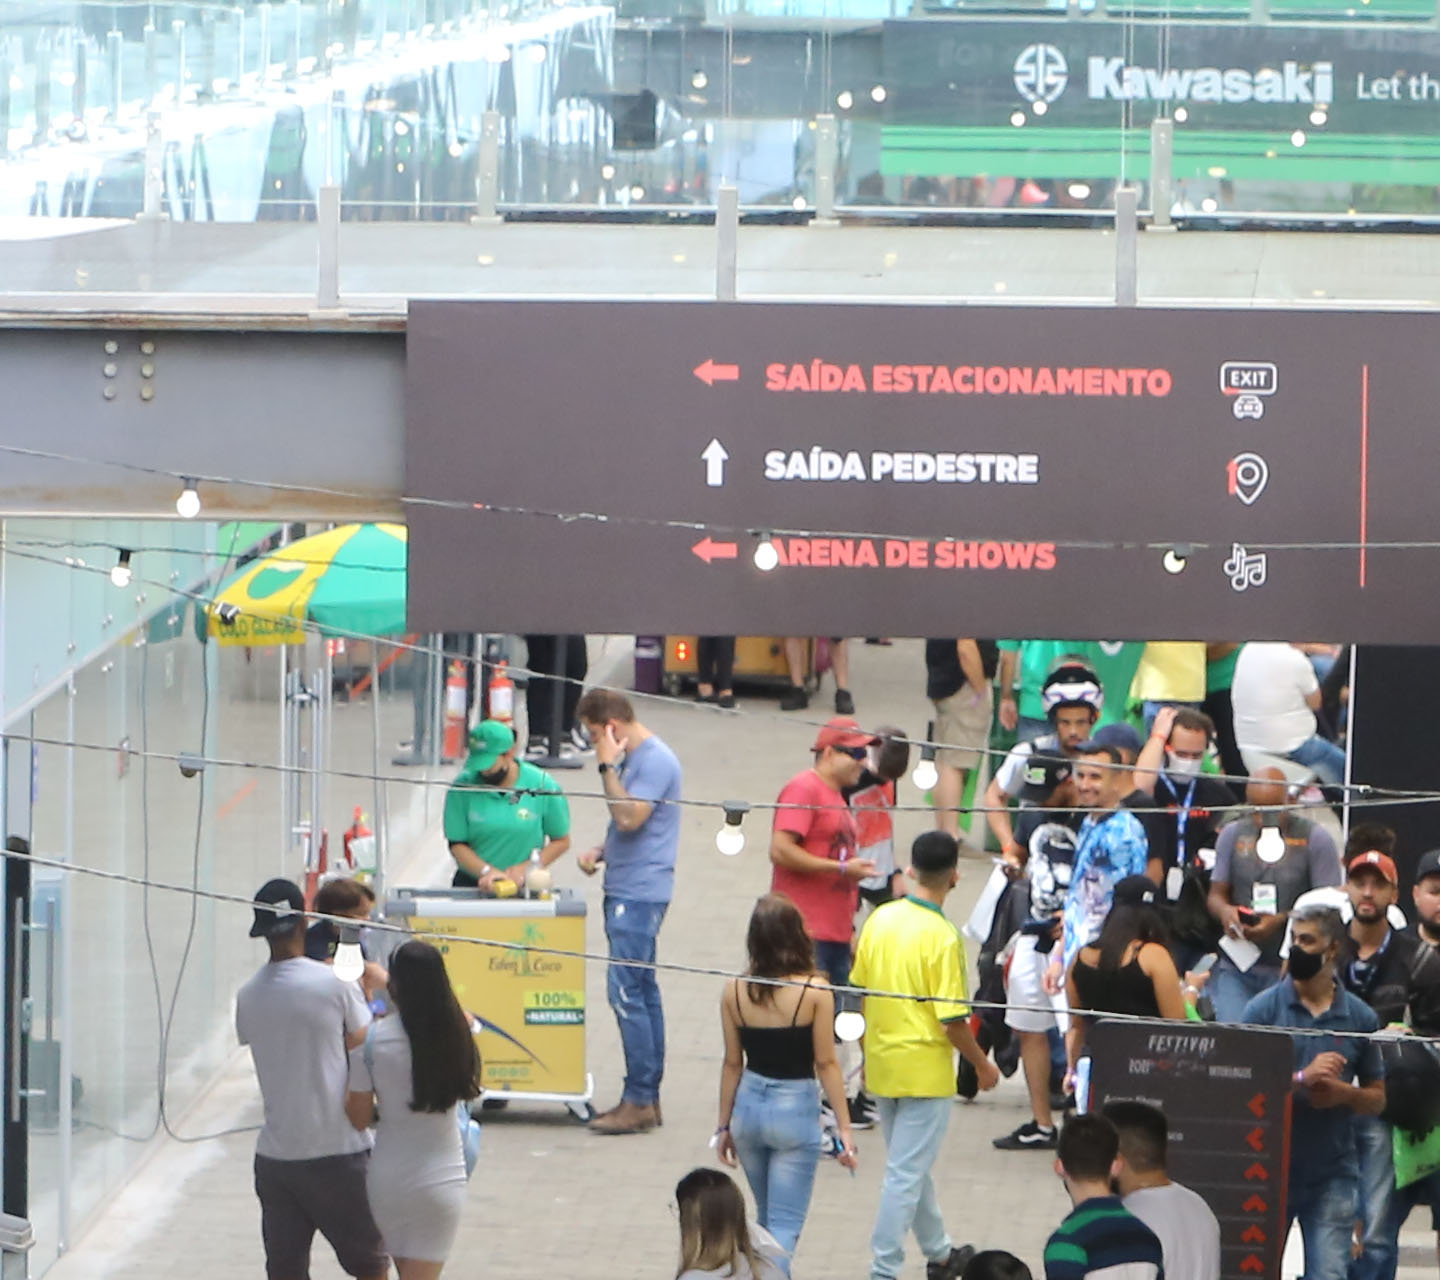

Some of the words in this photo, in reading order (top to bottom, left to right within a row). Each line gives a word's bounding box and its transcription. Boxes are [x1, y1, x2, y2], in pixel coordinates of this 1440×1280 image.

[1088, 56, 1332, 103] Kawasaki
[1357, 71, 1402, 99] Let
[765, 358, 866, 393] SAÍDA
[872, 367, 1172, 397] ESTACIONAMENTO
[1229, 368, 1268, 388] EXIT
[764, 446, 866, 482] SAÍDA
[871, 452, 1039, 485] PEDESTRE
[768, 539, 878, 569] ARENA
[885, 540, 943, 569] DE
[948, 541, 1056, 570] SHOWS
[534, 992, 577, 1006] 100%
